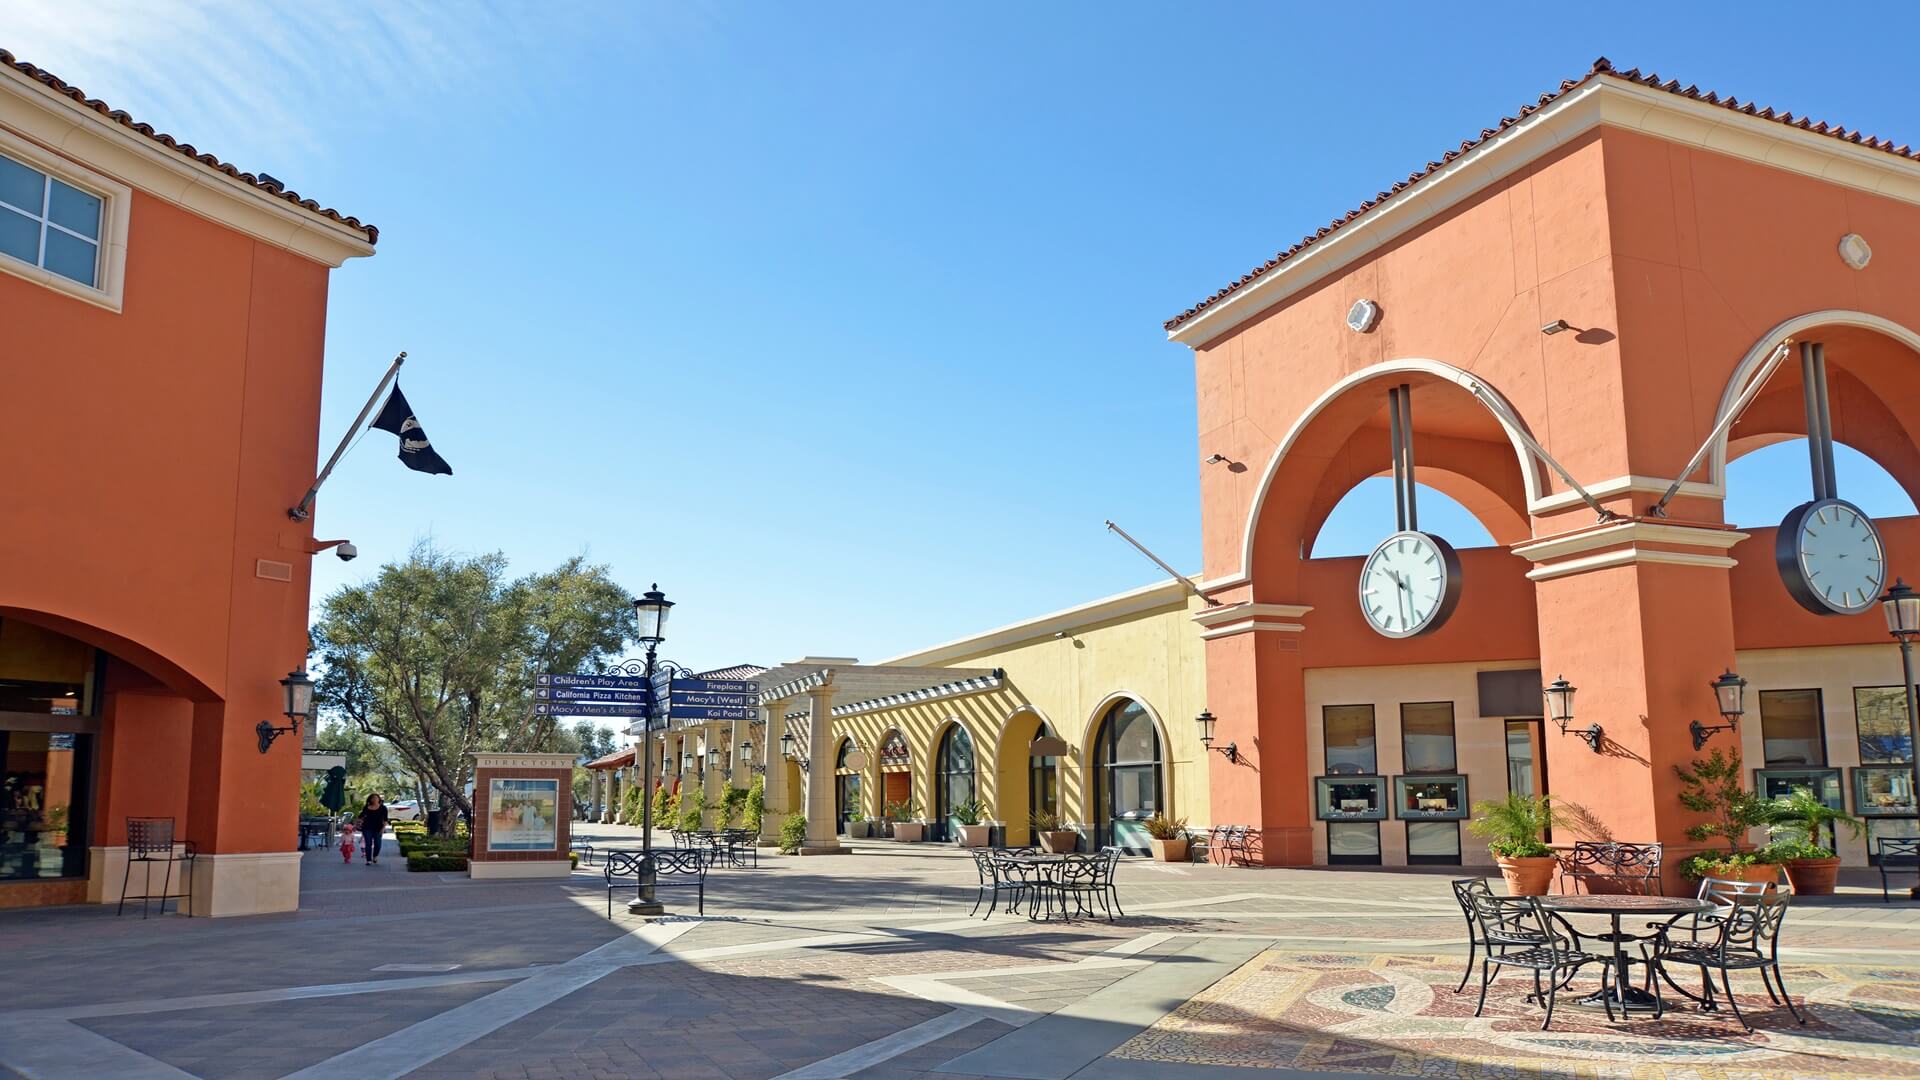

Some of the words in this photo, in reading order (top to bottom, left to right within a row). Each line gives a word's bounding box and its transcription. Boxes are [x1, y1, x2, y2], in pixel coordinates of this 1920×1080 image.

[554, 676, 595, 685] Children's
[598, 678, 615, 687] Play
[618, 679, 639, 687] Area
[707, 682, 743, 691] Fireplace
[556, 691, 590, 699] California
[593, 691, 612, 700] Pizza
[614, 692, 641, 701] Kitchen
[686, 696, 715, 704] Macy's
[717, 696, 743, 704] (West)
[550, 705, 579, 714] Macy's
